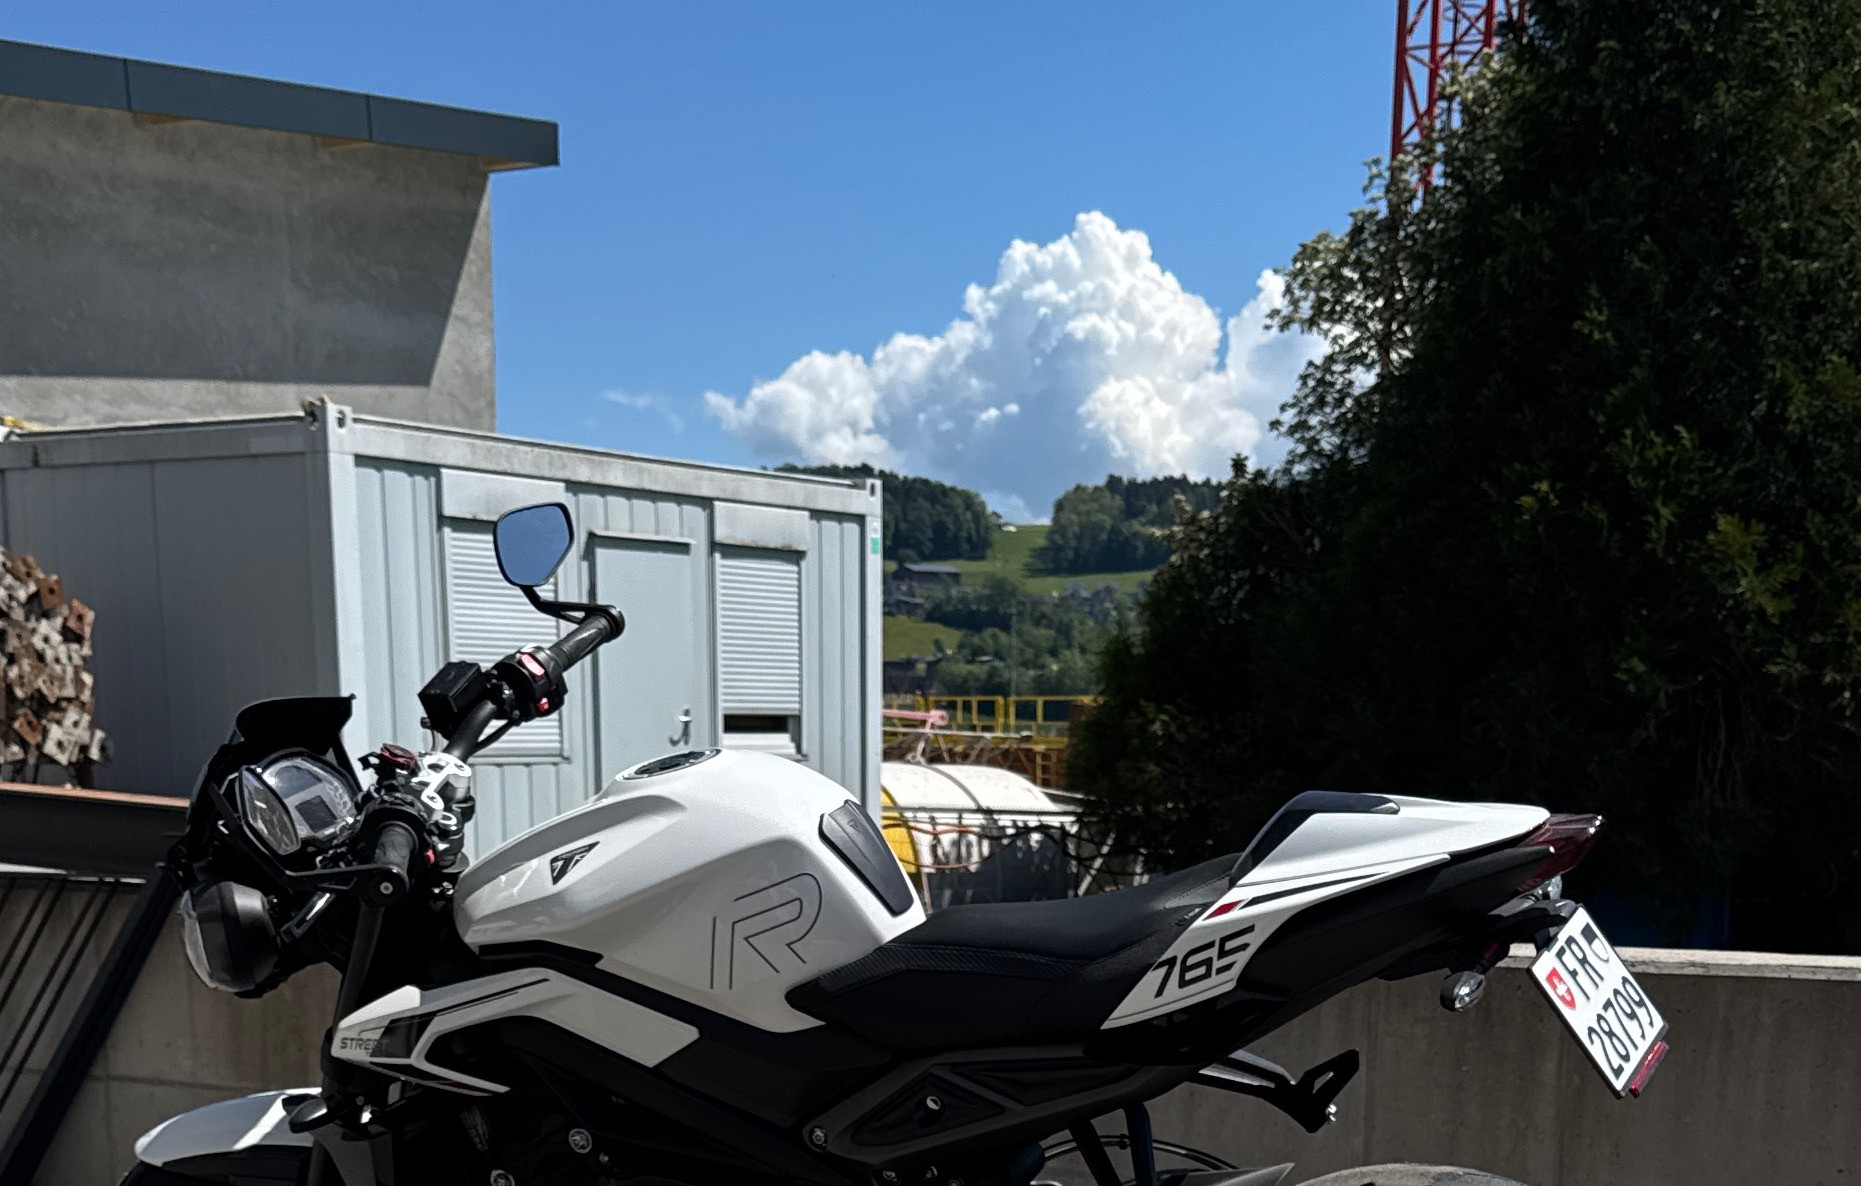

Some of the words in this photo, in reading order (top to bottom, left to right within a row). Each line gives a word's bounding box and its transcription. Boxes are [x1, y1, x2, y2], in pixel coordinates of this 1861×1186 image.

[710, 872, 823, 990] R
[1150, 924, 1256, 1000] 765
[1555, 934, 1605, 1002] FR
[1587, 975, 1655, 1081] 28799
